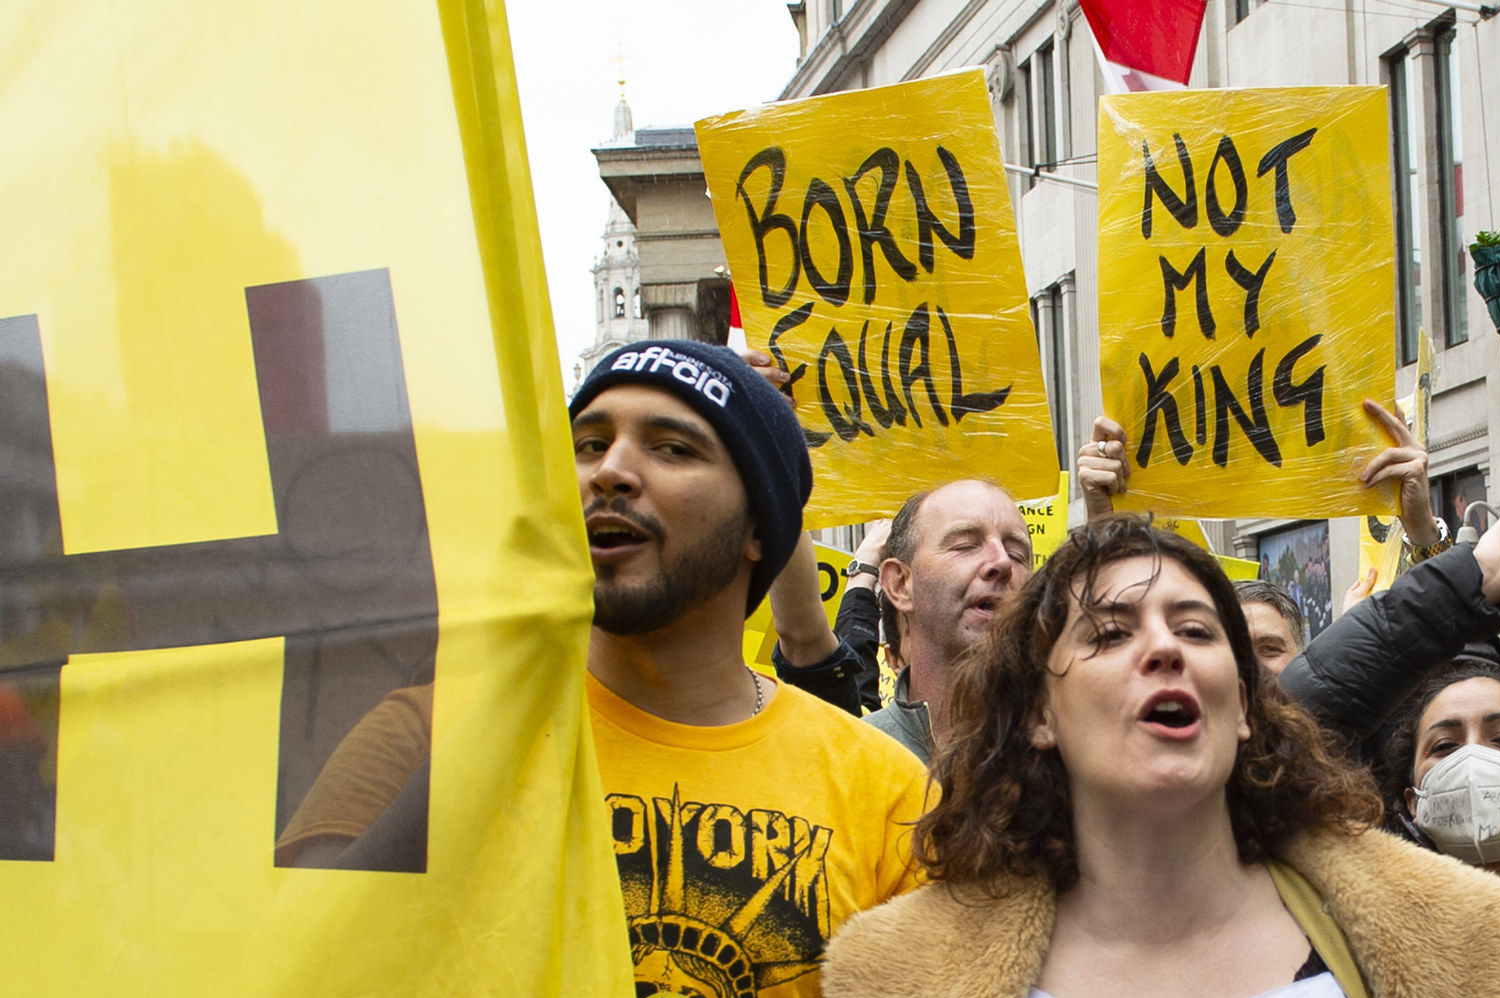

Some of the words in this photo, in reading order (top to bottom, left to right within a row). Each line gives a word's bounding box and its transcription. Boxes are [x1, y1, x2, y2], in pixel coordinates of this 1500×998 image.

[736, 145, 976, 309] BORN
[1141, 127, 1318, 240] NOT
[1159, 246, 1278, 341] MY
[666, 348, 737, 394] MINNESOTA
[768, 301, 1013, 448] EQUAL
[1135, 333, 1328, 469] KING
